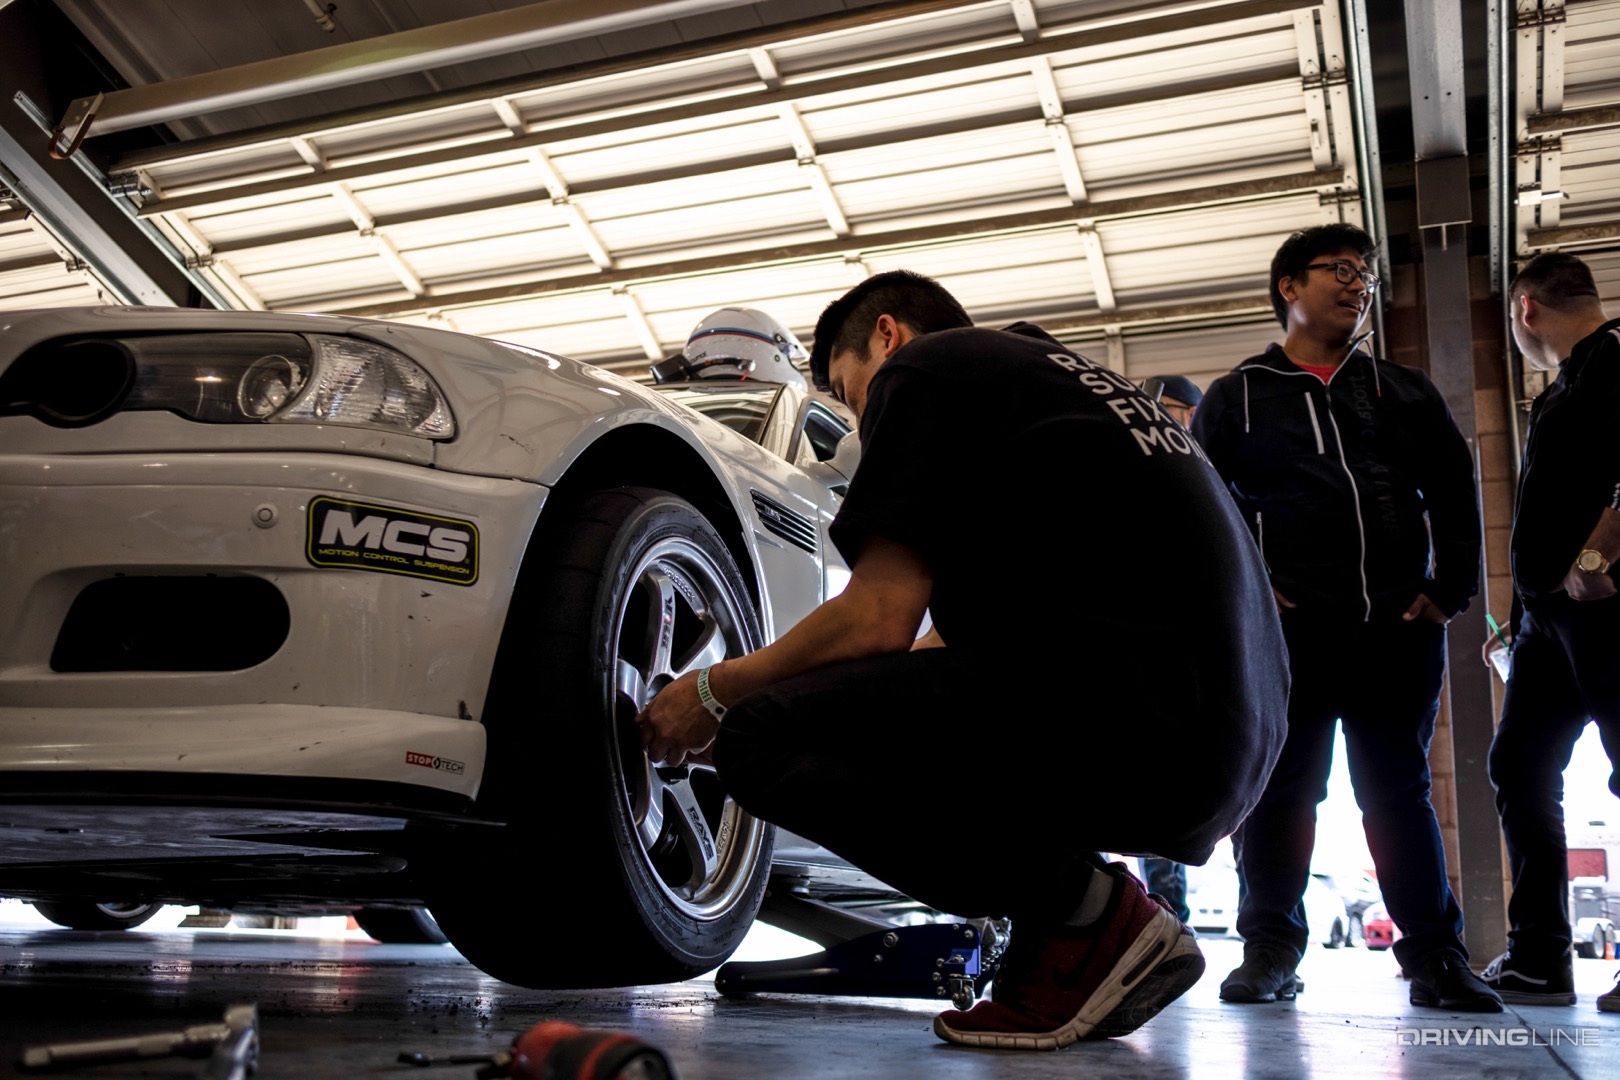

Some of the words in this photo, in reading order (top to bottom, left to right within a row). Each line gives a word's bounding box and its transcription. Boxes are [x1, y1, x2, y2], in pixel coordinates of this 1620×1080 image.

[1106, 397, 1172, 425] FIX
[318, 508, 471, 564] MCS
[318, 548, 360, 558] MOTION
[363, 552, 410, 565] CONTROL
[413, 558, 470, 575] SUSPENSION
[407, 753, 432, 766] STOP
[440, 759, 465, 773] TECH
